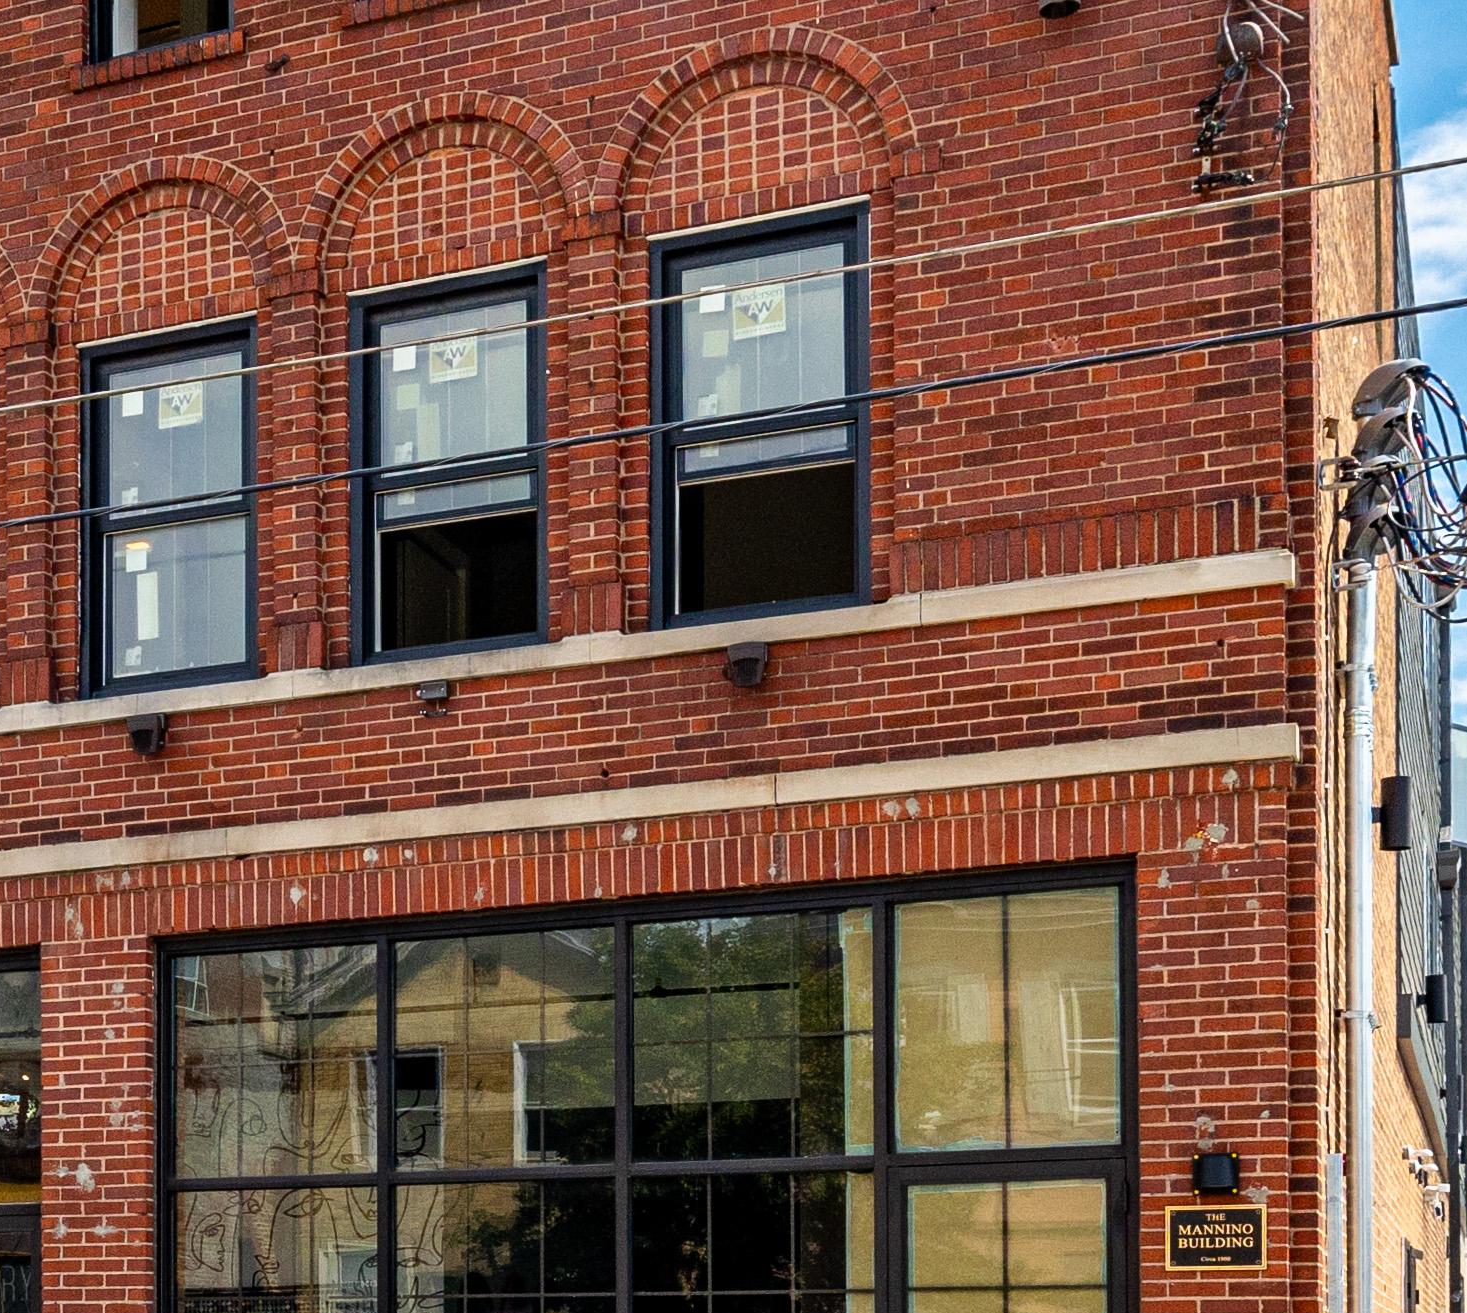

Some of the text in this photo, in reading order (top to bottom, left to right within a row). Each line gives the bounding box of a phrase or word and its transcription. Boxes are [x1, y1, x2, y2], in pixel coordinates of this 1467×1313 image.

[1205, 1213, 1226, 1222] THE
[1178, 1223, 1254, 1236] MANNINO
[1178, 1236, 1254, 1249] BUILDING
